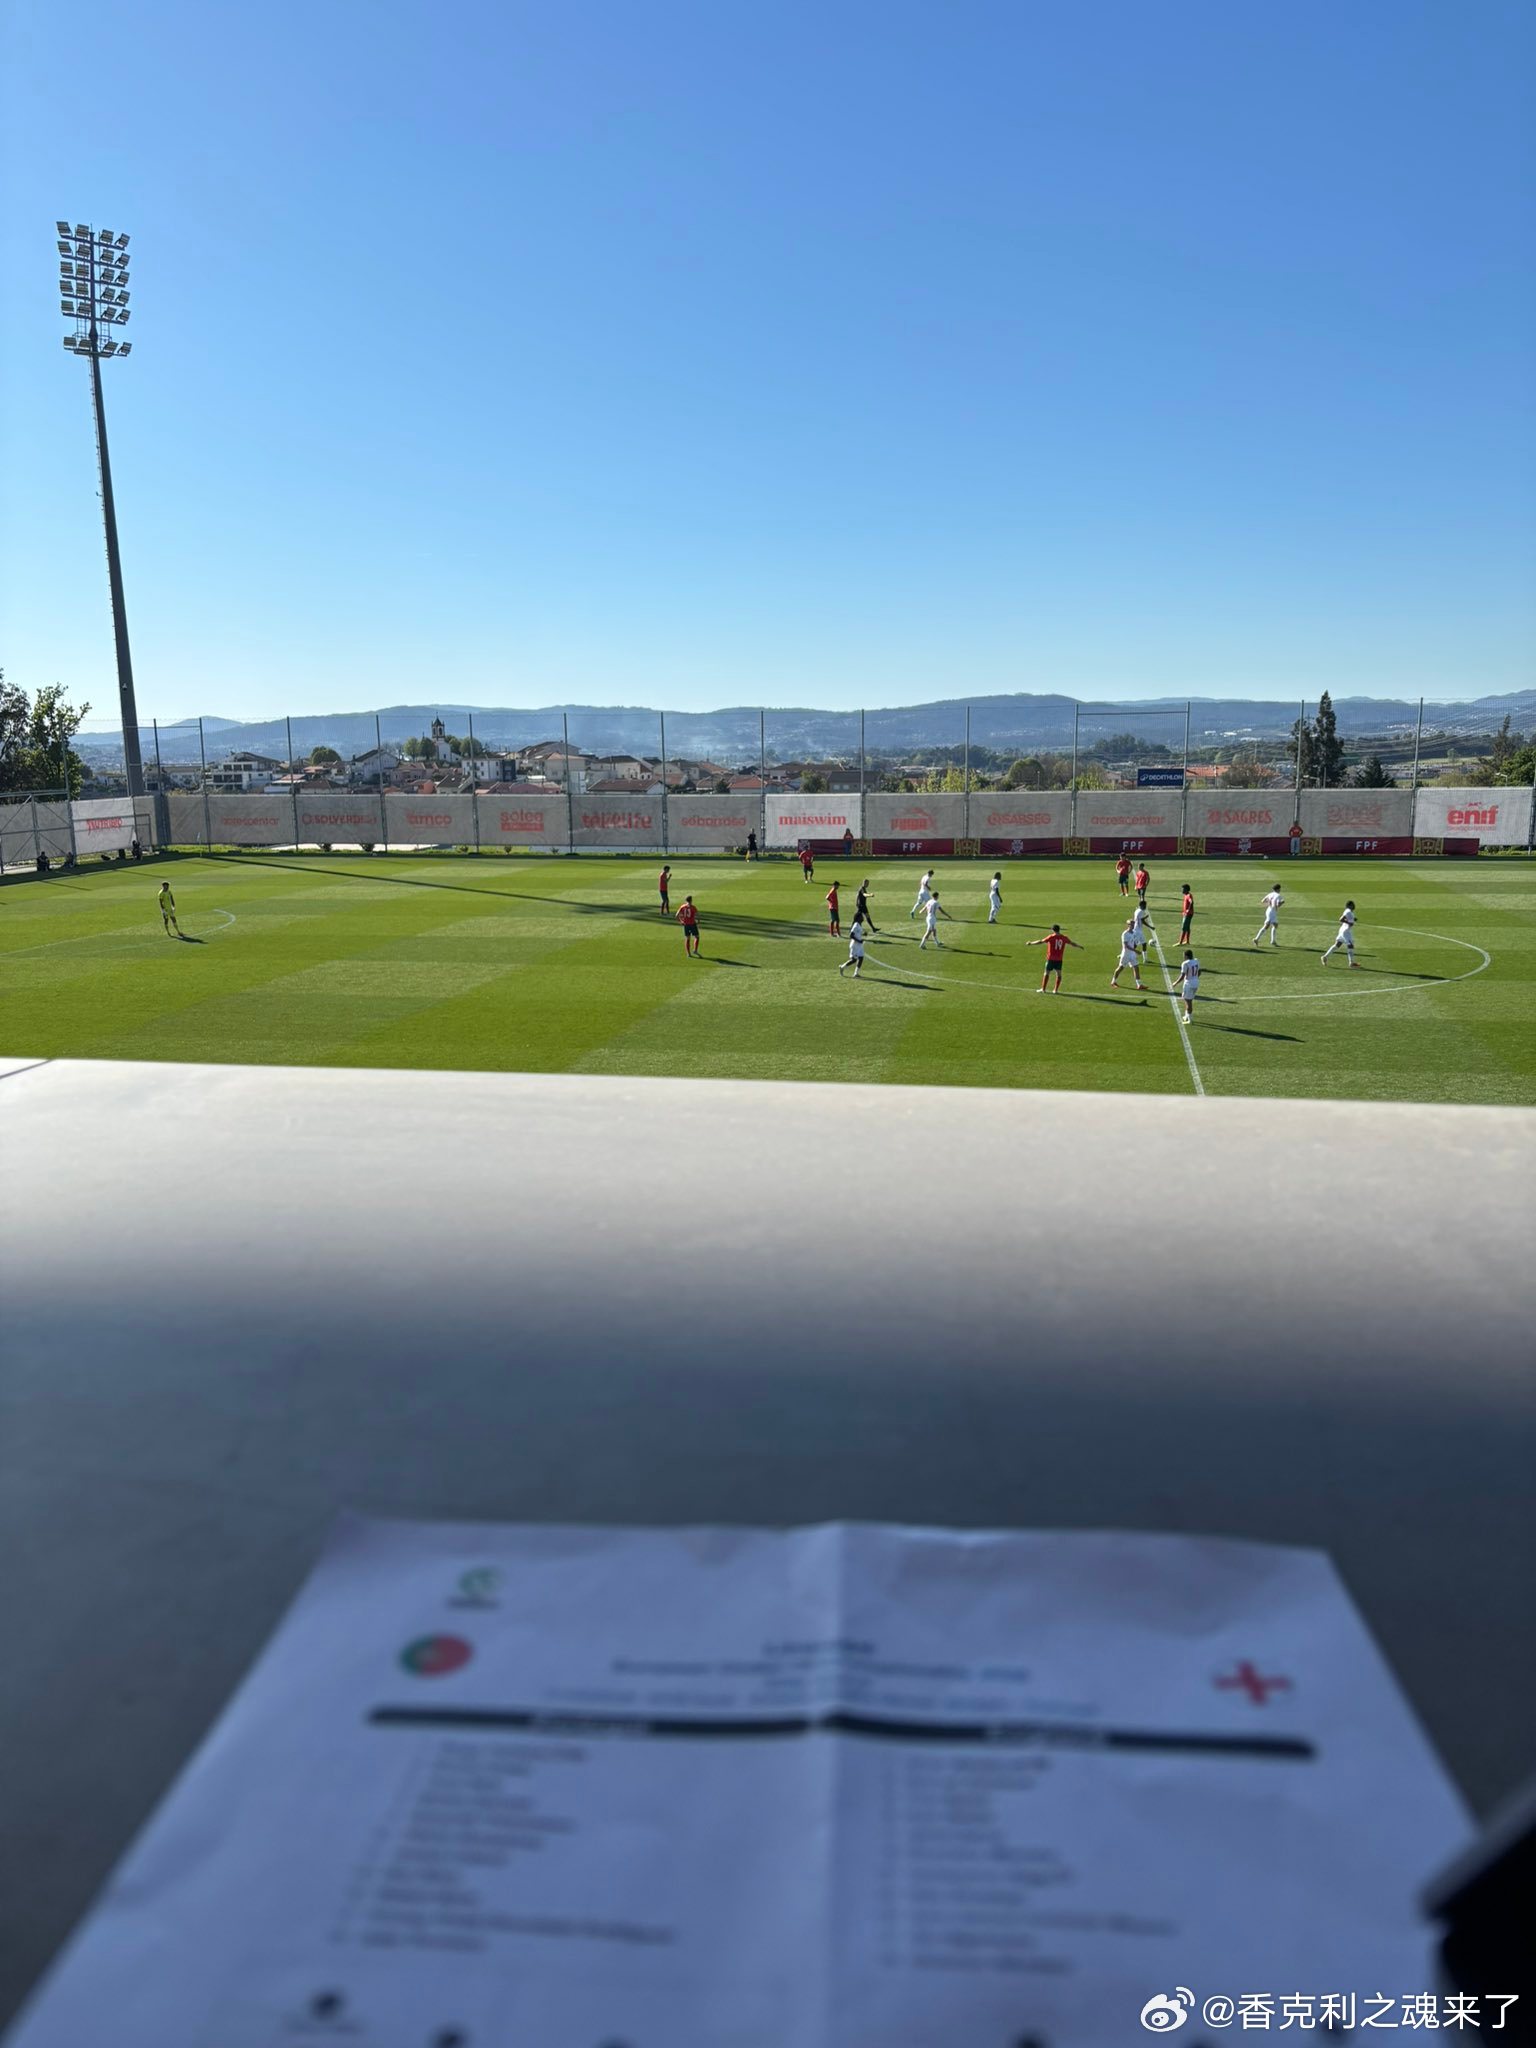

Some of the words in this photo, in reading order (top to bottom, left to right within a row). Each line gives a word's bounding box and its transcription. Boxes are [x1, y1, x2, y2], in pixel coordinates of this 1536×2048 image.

[778, 813, 847, 825] maiswim
[1223, 810, 1273, 824] SAGRES
[902, 842, 923, 852] FPF
[1122, 840, 1145, 851] FPF
[1355, 840, 1378, 851] FPF
